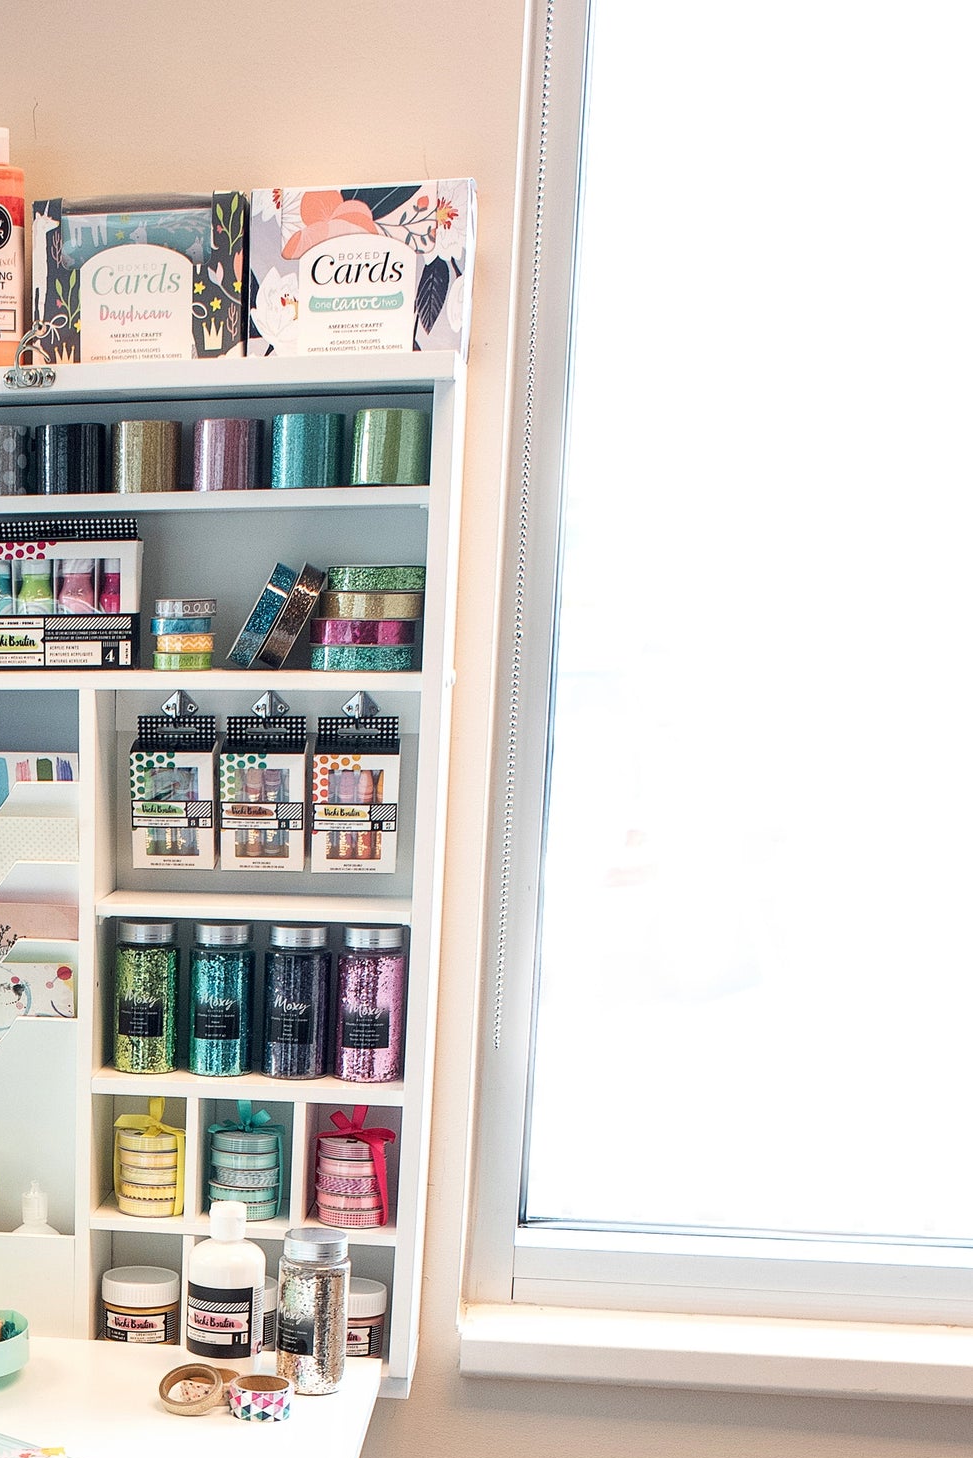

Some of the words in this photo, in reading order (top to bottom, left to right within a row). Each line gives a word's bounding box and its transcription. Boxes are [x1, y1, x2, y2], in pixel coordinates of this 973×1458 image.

[338, 252, 380, 261] BOXED
[311, 251, 404, 285] Cards
[92, 263, 181, 296] Cards
[315, 301, 331, 309] one
[332, 297, 381, 311] canoe
[381, 299, 397, 307] two
[99, 304, 172, 326] Daydream
[104, 648, 116, 663] 4
[324, 807, 339, 817] Vicki
[124, 989, 161, 1008] Moxy
[200, 991, 237, 1011] Moxy
[273, 994, 311, 1015] Moxy
[349, 1002, 386, 1020] Moxy
[114, 1316, 130, 1328] Vicki
[194, 1313, 209, 1326] Vicki
